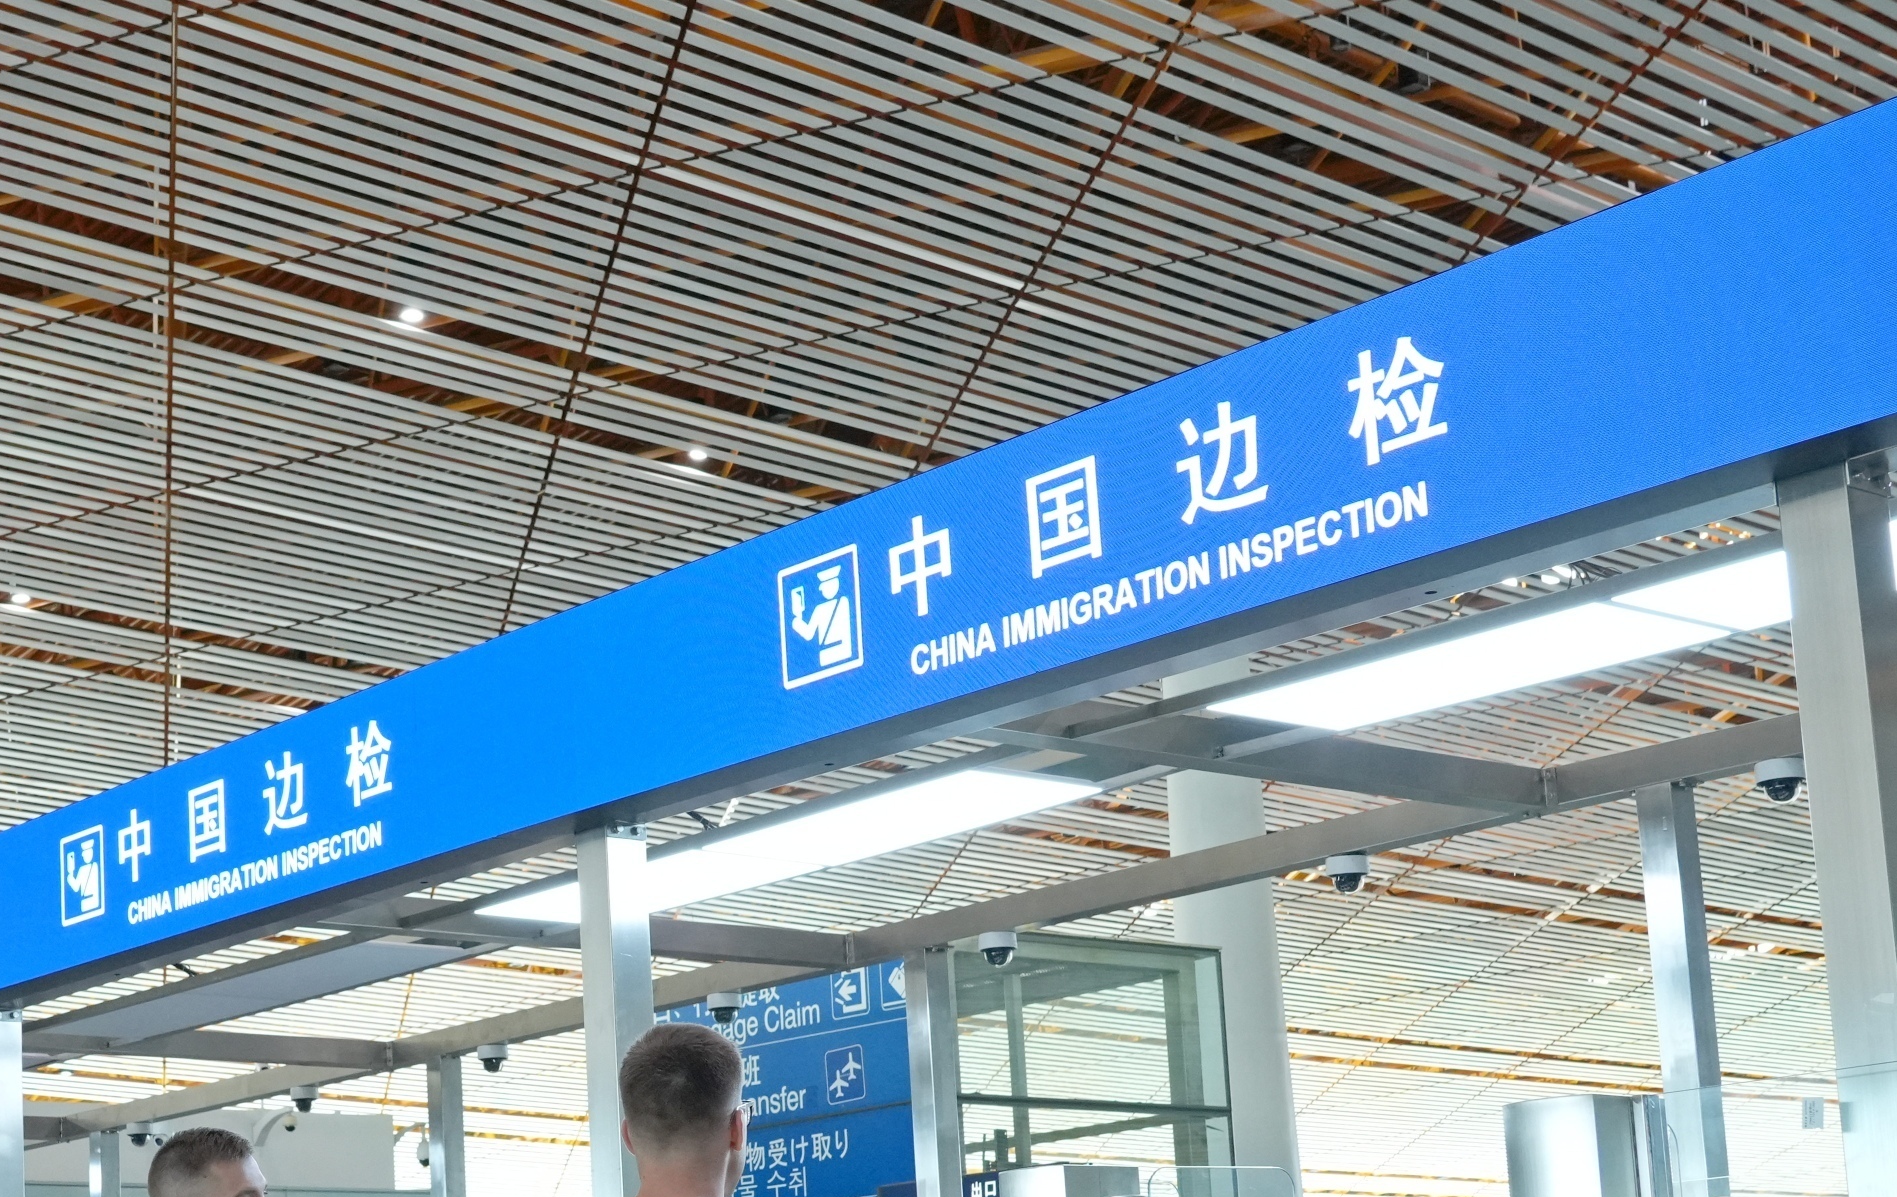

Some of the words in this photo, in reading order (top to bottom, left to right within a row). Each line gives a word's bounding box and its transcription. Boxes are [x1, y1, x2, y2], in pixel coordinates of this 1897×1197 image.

[888, 336, 1448, 617] 中国边检
[910, 626, 995, 676] CHINA
[1002, 562, 1212, 647] IMMIGRATION
[1219, 480, 1430, 582] INSPECTION
[117, 719, 393, 883] 中国边检
[127, 891, 172, 926] CHINA
[174, 854, 279, 912] IMMIGRATION
[281, 820, 383, 878] INSPECTION
[764, 1001, 820, 1033] Claim
[745, 1128, 849, 1172] 物受け取り
[749, 1085, 807, 1117] ansfer
